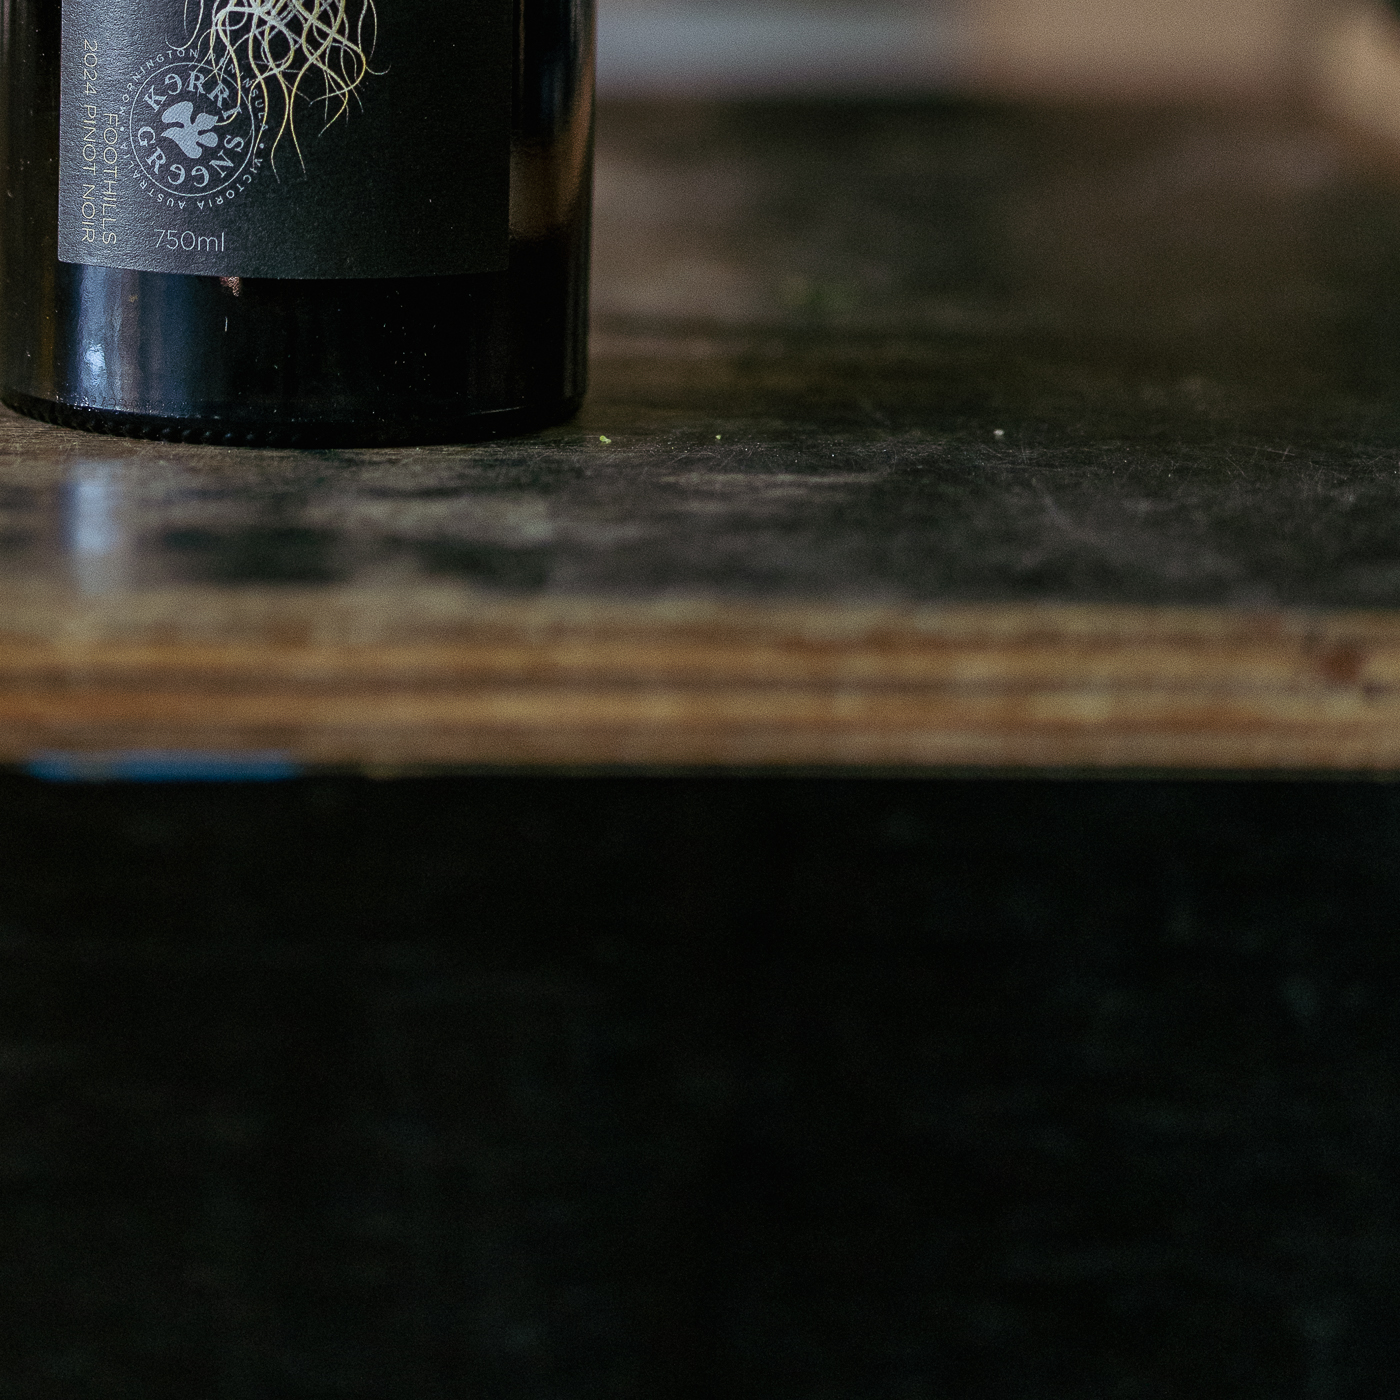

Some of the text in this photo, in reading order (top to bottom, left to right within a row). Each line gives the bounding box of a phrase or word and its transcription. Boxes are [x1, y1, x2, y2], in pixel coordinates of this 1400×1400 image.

[80, 39, 99, 244] 2024 PINOT NOIR
[101, 112, 118, 245] FOOTHILLS
[154, 229, 225, 252] 750ml
